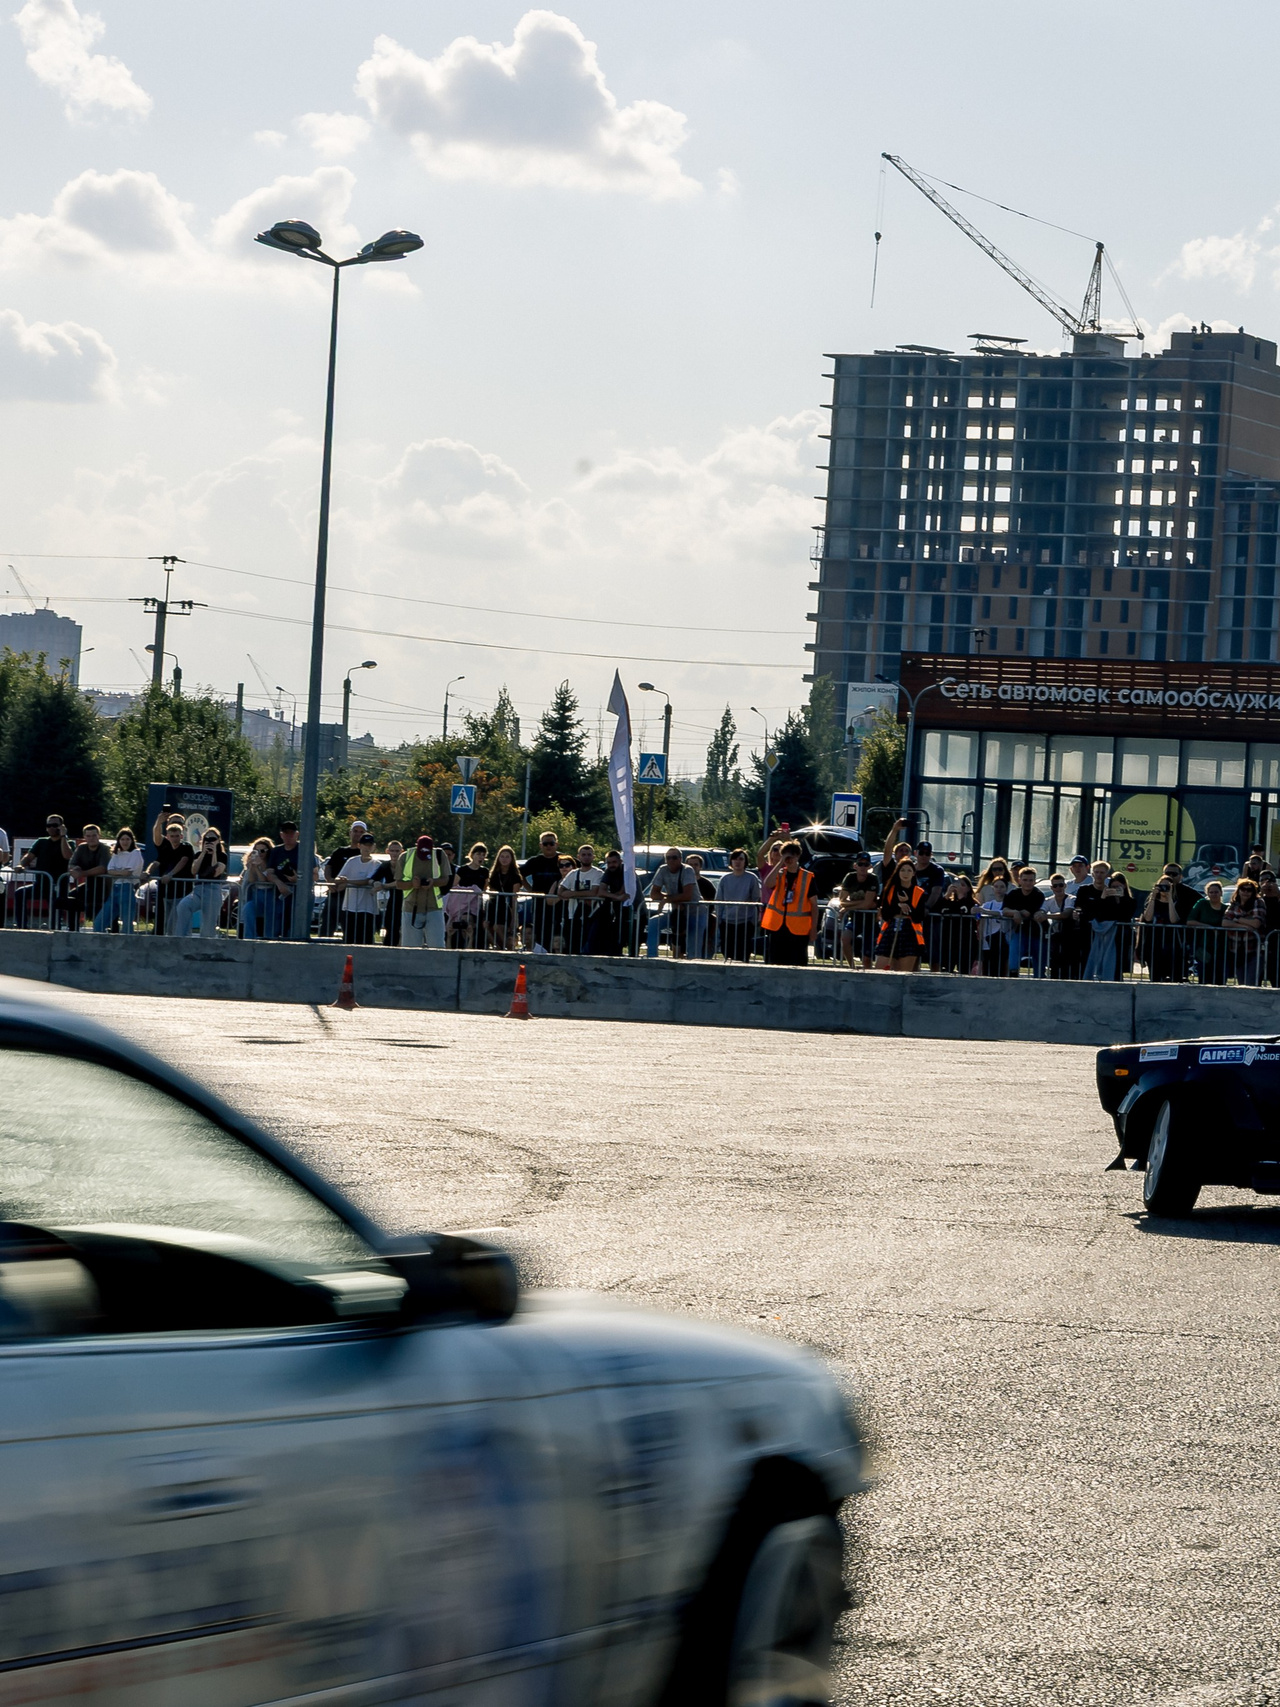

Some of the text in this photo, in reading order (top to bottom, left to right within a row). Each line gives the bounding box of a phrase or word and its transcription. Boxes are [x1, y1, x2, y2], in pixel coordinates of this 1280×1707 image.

[939, 676, 992, 699] Сеть
[998, 683, 1110, 704] автомоек
[1120, 817, 1149, 826] Ночью
[1120, 828, 1161, 836] выгоднее
[1202, 1049, 1243, 1061] AIMOL
